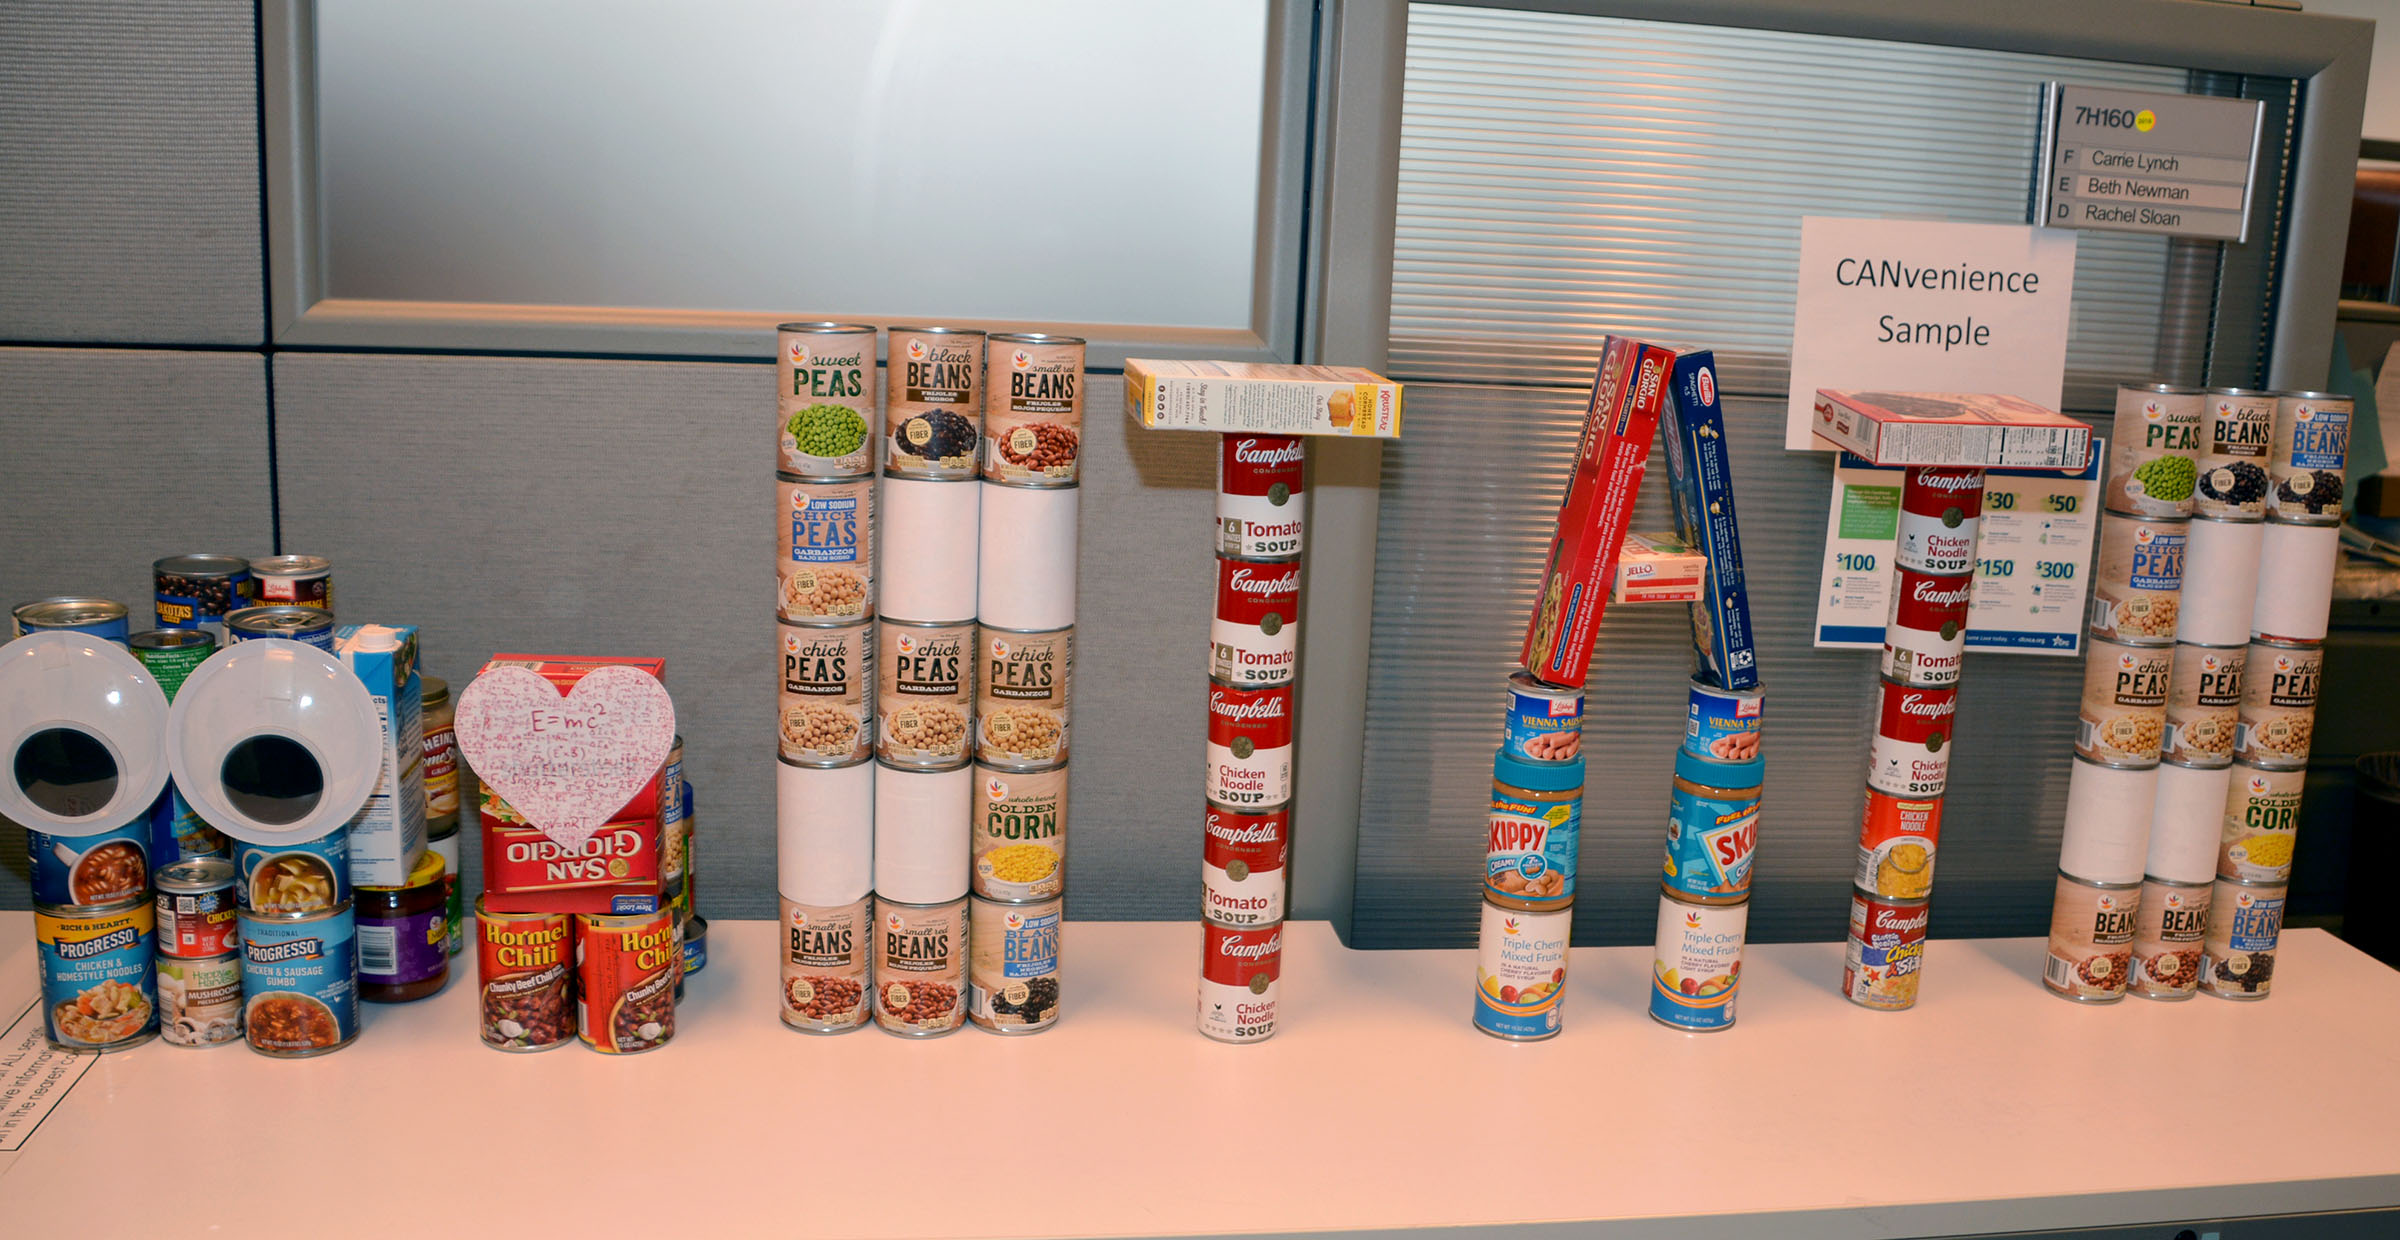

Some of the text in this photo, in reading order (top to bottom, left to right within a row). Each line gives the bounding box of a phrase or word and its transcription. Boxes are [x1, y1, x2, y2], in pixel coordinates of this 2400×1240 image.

[2075, 107, 2135, 129] 7H160
[2064, 150, 2179, 173] F Carrie Lynch
[2059, 177, 2189, 200] E Beth Newman
[2058, 205, 2180, 226] D Rachel Sloan
[1836, 258, 2039, 294] CANvenience
[1878, 315, 1990, 351] Sample
[811, 352, 861, 366] sweet
[929, 348, 972, 363] black
[793, 368, 862, 397] PEAS
[907, 362, 972, 389] BEANS
[1637, 358, 1654, 409] GIORGIO
[1011, 372, 1074, 398] BEANS
[1647, 372, 1660, 397] SAN
[1687, 372, 1699, 406] SPAGHETTI
[1701, 375, 1712, 403] Barilla
[1360, 391, 1368, 429] CORNBREAD
[1378, 389, 1390, 431] KRUSTEAZ
[1584, 350, 1616, 460] GIORGIO
[1598, 381, 1616, 430] SAN
[2236, 407, 2270, 421] black
[2214, 420, 2270, 444] BEANS
[2294, 422, 2348, 433] BLACK
[1014, 440, 1033, 448] FIBER
[2146, 424, 2200, 450] PEAS
[2293, 430, 2347, 454] BEANS
[812, 500, 855, 509] LOW SODIUM
[1986, 492, 2077, 512] $30 $50
[792, 511, 856, 520] CHICK
[792, 521, 856, 546] PEAS
[1229, 522, 1235, 533] 6
[1245, 521, 1302, 536] Tomato
[1255, 540, 1297, 552] SOUP
[1927, 535, 1970, 547] Chicken
[1927, 546, 1968, 558] Noodle
[1626, 565, 1654, 577] JELL-O
[1836, 553, 2074, 579] $100 $150 $300
[1925, 559, 1967, 570] SOUP
[2132, 553, 2184, 577] PEAS
[797, 580, 814, 588] FIBER
[802, 641, 848, 657] chick
[915, 640, 960, 656] chick
[1010, 646, 1054, 662] chick
[1220, 648, 1227, 658] 6
[1236, 649, 1293, 665] Tomato
[786, 654, 846, 682] PEAS
[896, 656, 958, 682] PEAS
[991, 660, 1052, 686] PEAS
[1245, 669, 1287, 680] SOUP
[1923, 671, 1958, 681] SOUP
[788, 683, 844, 693] GARBANZOS
[899, 684, 956, 693] GARBANZOS
[2116, 672, 2168, 696] PEAS
[2272, 673, 2319, 696] PEAS
[993, 688, 1050, 697] GARBANZOS
[1210, 691, 1284, 721] Campbell's
[1522, 715, 1558, 727] VIENNA
[1709, 716, 1744, 727] VIENNA
[1220, 765, 1265, 779] Chicken
[1220, 777, 1264, 790] Noodle
[1909, 782, 1943, 792] SOUP
[1219, 790, 1264, 802] SOUP
[988, 802, 1056, 813] GOLDEN
[1900, 810, 1929, 822] CHICKEN
[987, 812, 1056, 840] CORN
[1206, 814, 1278, 845] Campbell's
[1901, 821, 1926, 831] NOODLE
[547, 858, 606, 880] SAN
[1491, 859, 1515, 872] CREAMY
[1208, 888, 1268, 910] Tomato
[637, 904, 652, 912] New
[1214, 909, 1258, 923] SOUP
[92, 918, 130, 930] HEARTY
[1025, 919, 1039, 928] LOW
[2232, 915, 2282, 938] BEANS
[257, 929, 299, 937] TRADITIONAL
[486, 920, 567, 946] Hormel
[1005, 926, 1058, 939] BLACK
[1684, 931, 1712, 944] Triple
[59, 929, 135, 958] PROGRESSO
[791, 928, 852, 954] BEANS
[887, 934, 948, 960] BEANS
[1004, 934, 1059, 962] BEANS
[1503, 937, 1531, 951] Triple
[247, 940, 316, 963] PROGRESSO
[498, 944, 557, 966] Chili
[1501, 950, 1558, 962] Mixed Fruit
[1682, 944, 1736, 955] Mixed Fruit
[56, 964, 142, 981] HOMESTYLE NOODLES
[75, 959, 122, 971] CHICKEN &
[246, 964, 323, 976] CHICKEN & SAUSAGE
[266, 976, 296, 986] GUMBO
[489, 983, 516, 992] Chunky
[516, 978, 535, 990] Beef
[536, 971, 553, 984] Chili
[627, 983, 655, 1001] Chunky
[1236, 1001, 1276, 1014] Chicken
[1237, 1011, 1274, 1025] Noodle
[1235, 1022, 1274, 1037] SOUP
[30, 1067, 67, 1099] nearest
